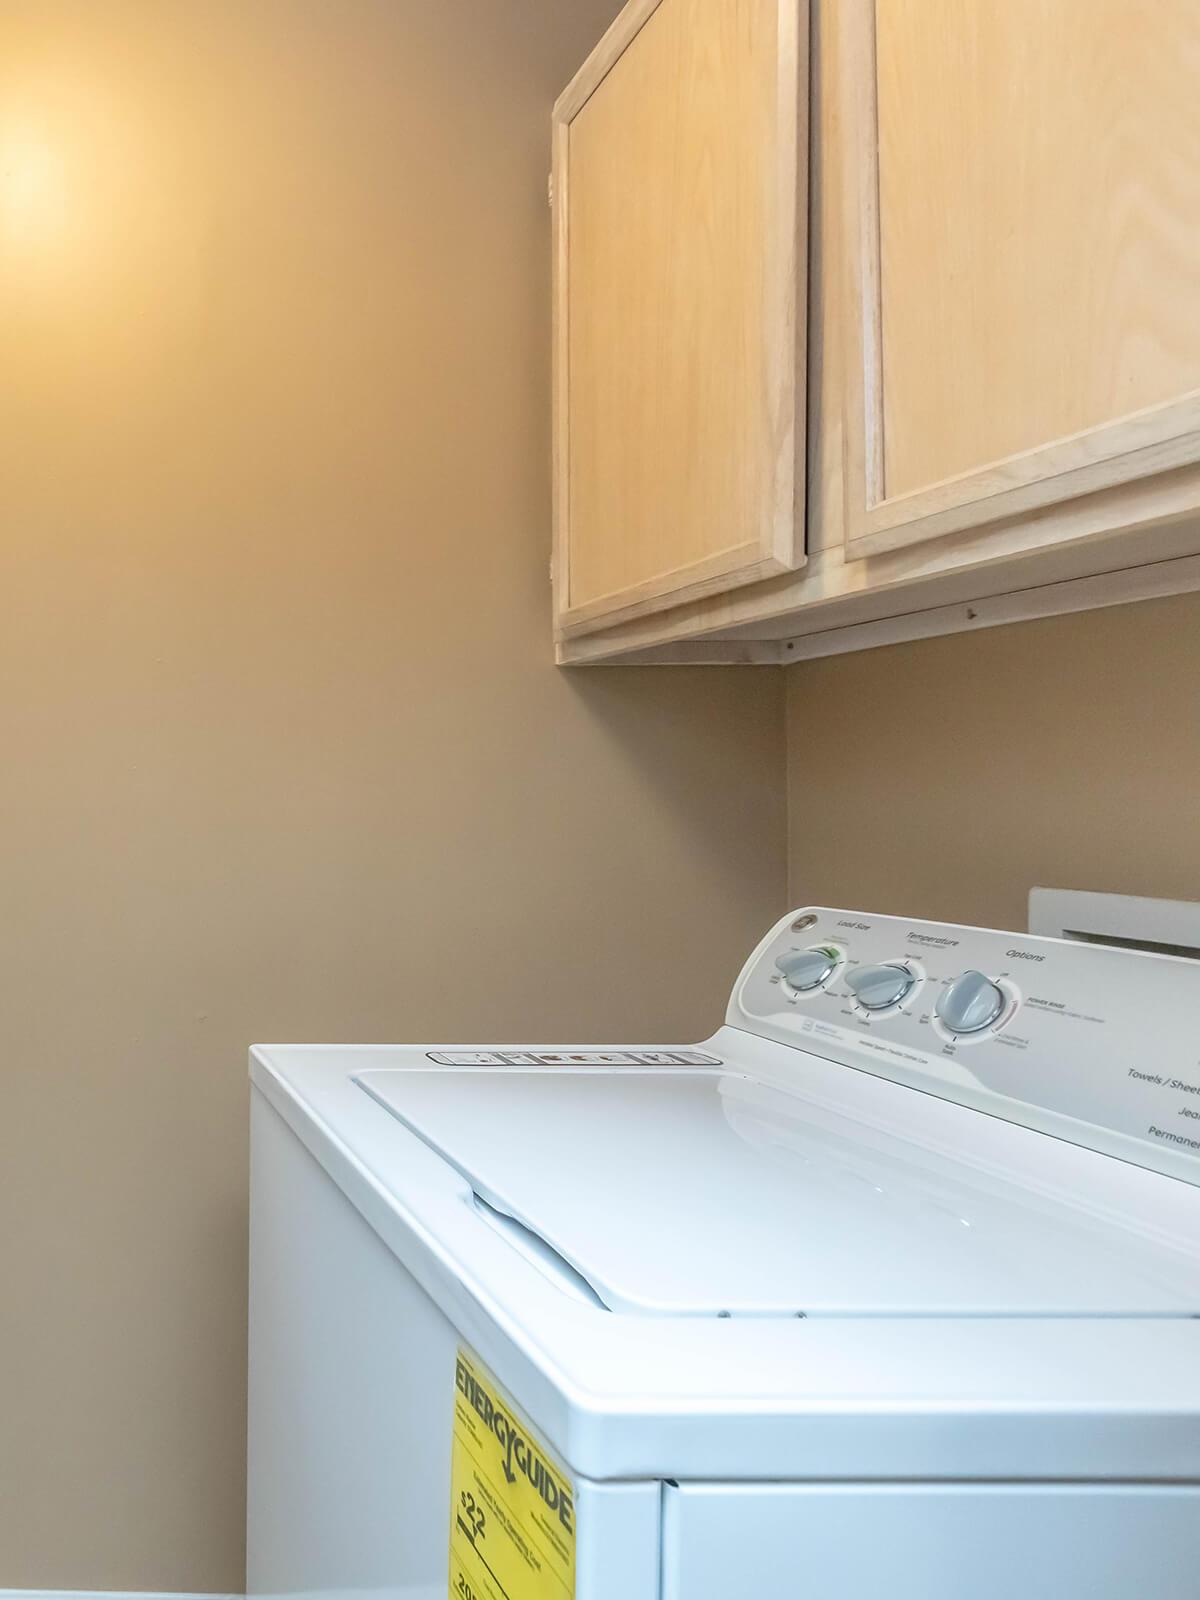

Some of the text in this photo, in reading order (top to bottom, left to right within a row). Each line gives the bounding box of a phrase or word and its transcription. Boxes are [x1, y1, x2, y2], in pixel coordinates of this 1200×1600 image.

[836, 920, 872, 931] Load Size
[906, 931, 960, 947] Temperature
[1005, 949, 1047, 963] Options
[1128, 1068, 1162, 1085] Towels
[1178, 1107, 1200, 1121] Jea
[461, 1491, 486, 1540] $22
